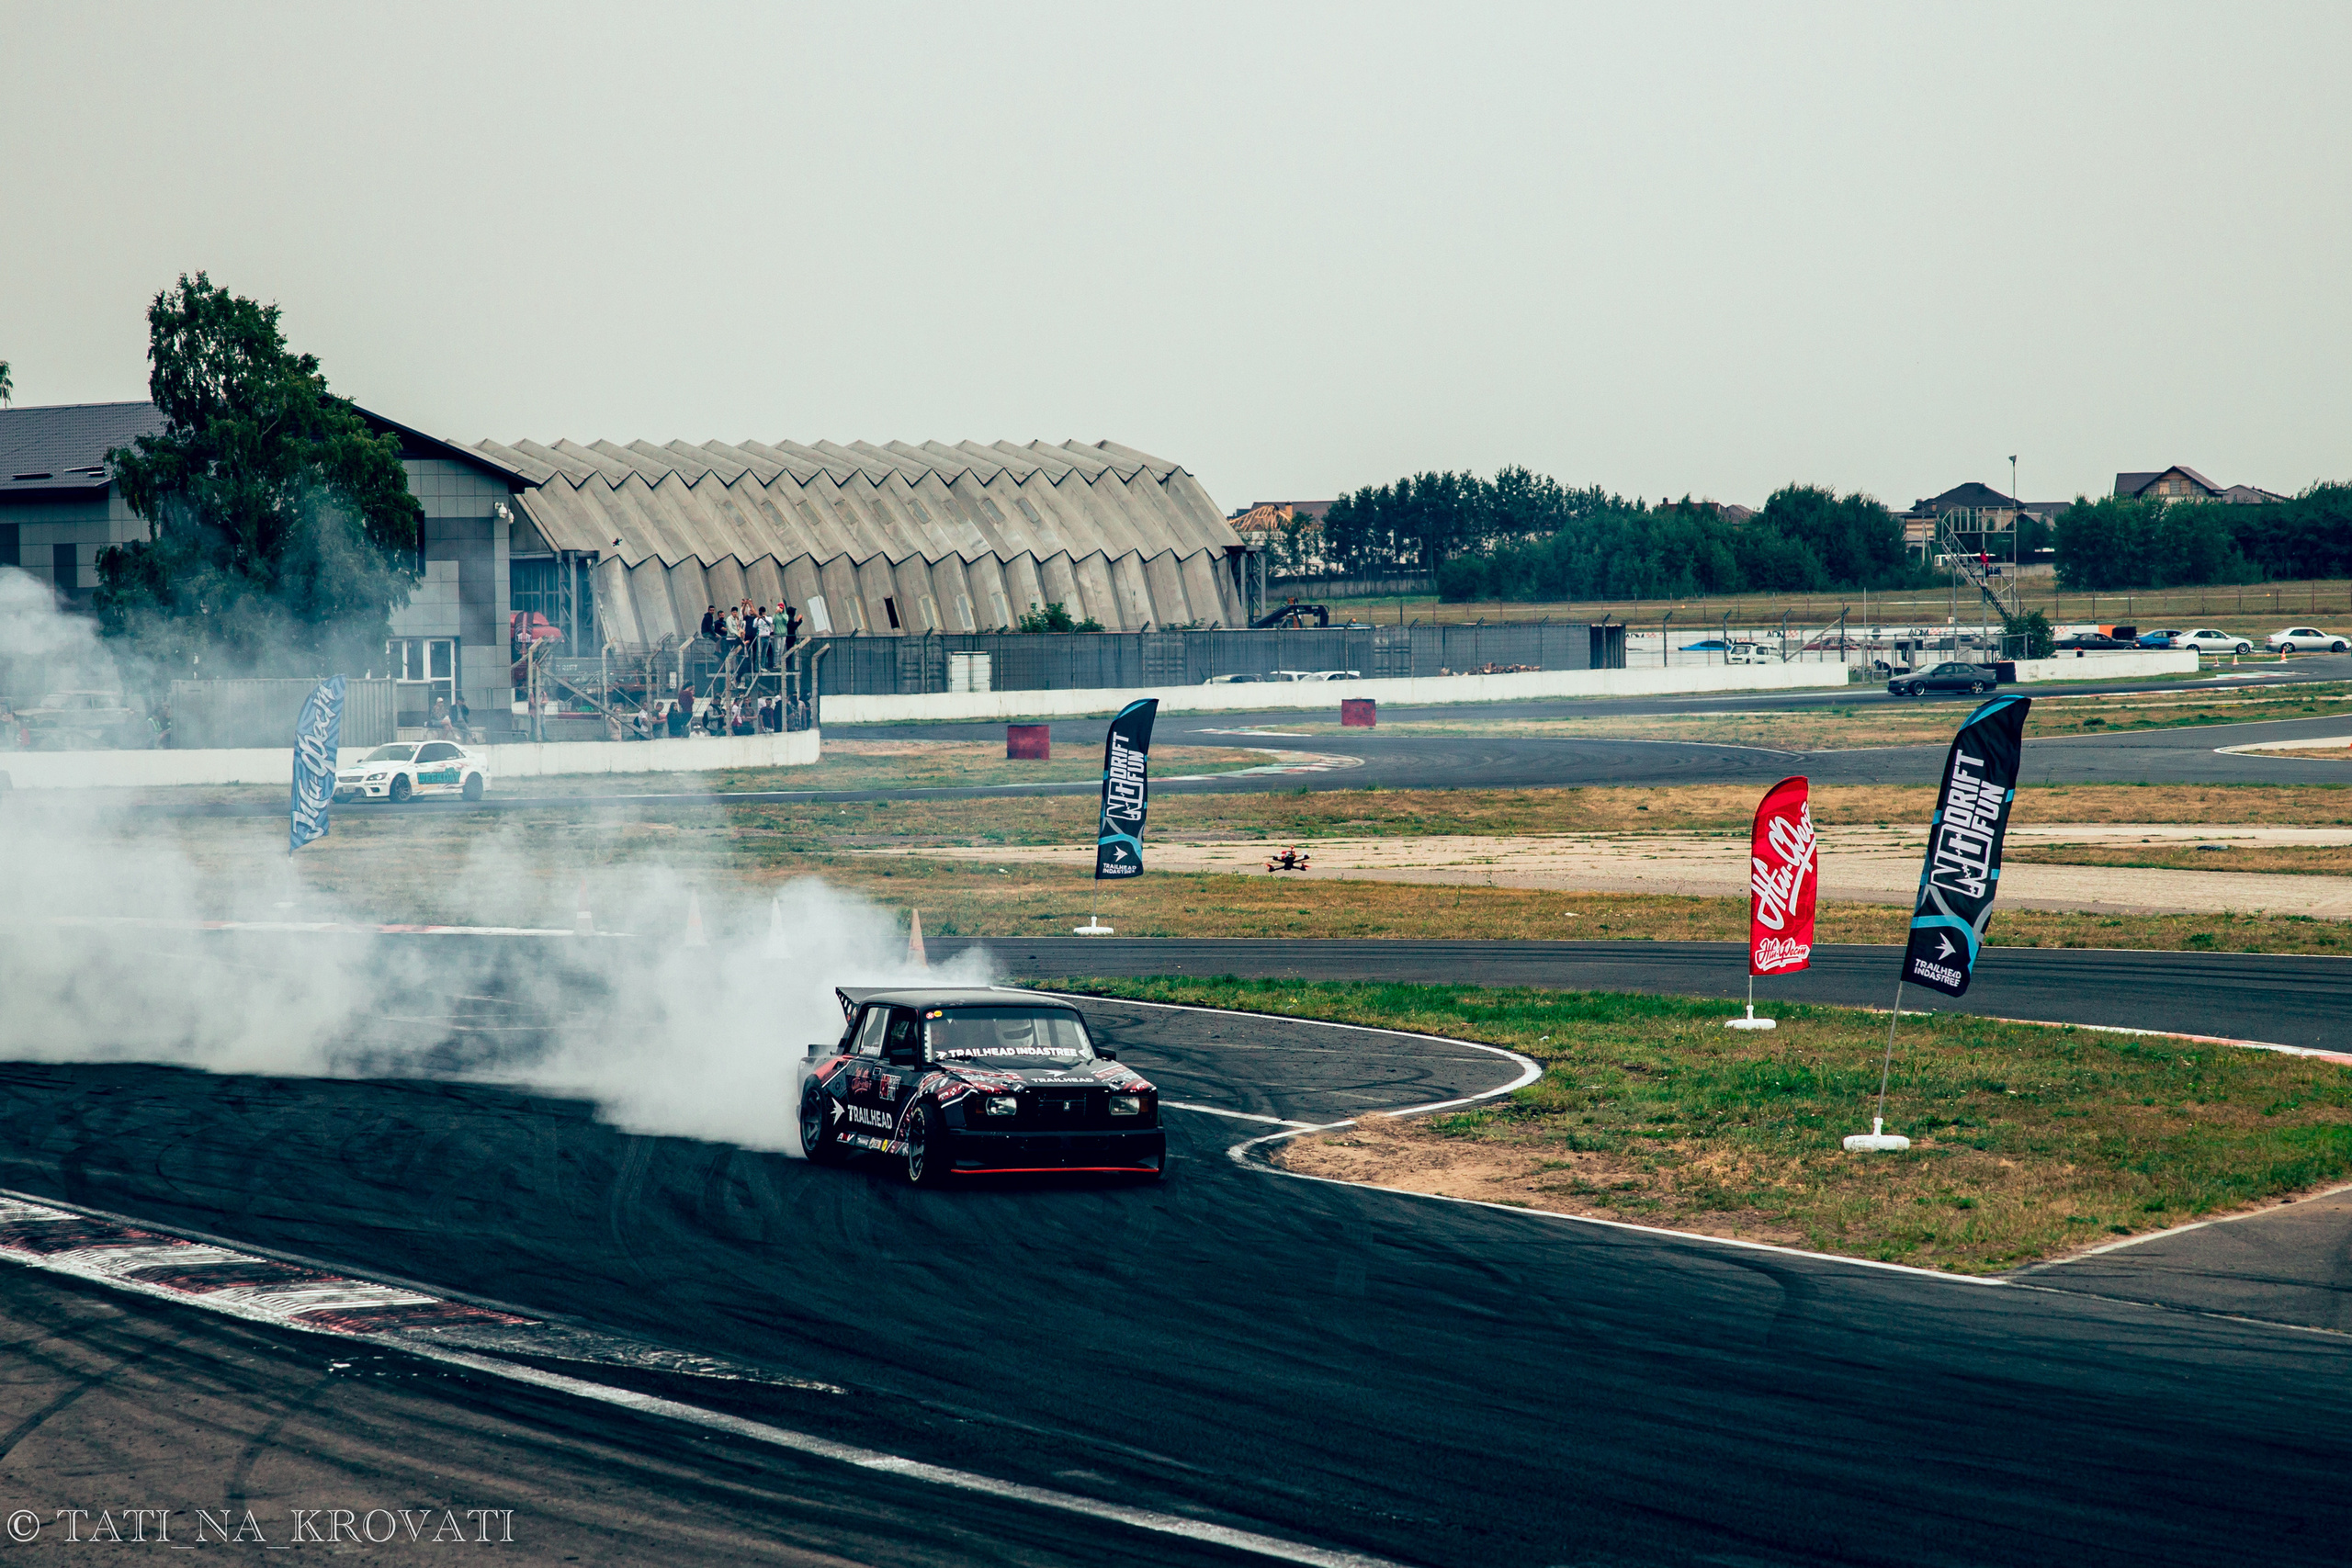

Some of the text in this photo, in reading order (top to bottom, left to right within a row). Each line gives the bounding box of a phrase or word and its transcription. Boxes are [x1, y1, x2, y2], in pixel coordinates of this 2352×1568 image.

[1110, 731, 1129, 780] DRIFT
[1126, 750, 1145, 783] FUN
[418, 772, 460, 784] WEEKDAY
[1943, 749, 1984, 829] DRIFT
[1971, 781, 2006, 837] FUN
[1914, 966, 1961, 987] INDASTREE
[948, 1047, 1078, 1058] TRAILHEAD INDASTREE
[847, 1104, 893, 1130] TRAILHEAD
